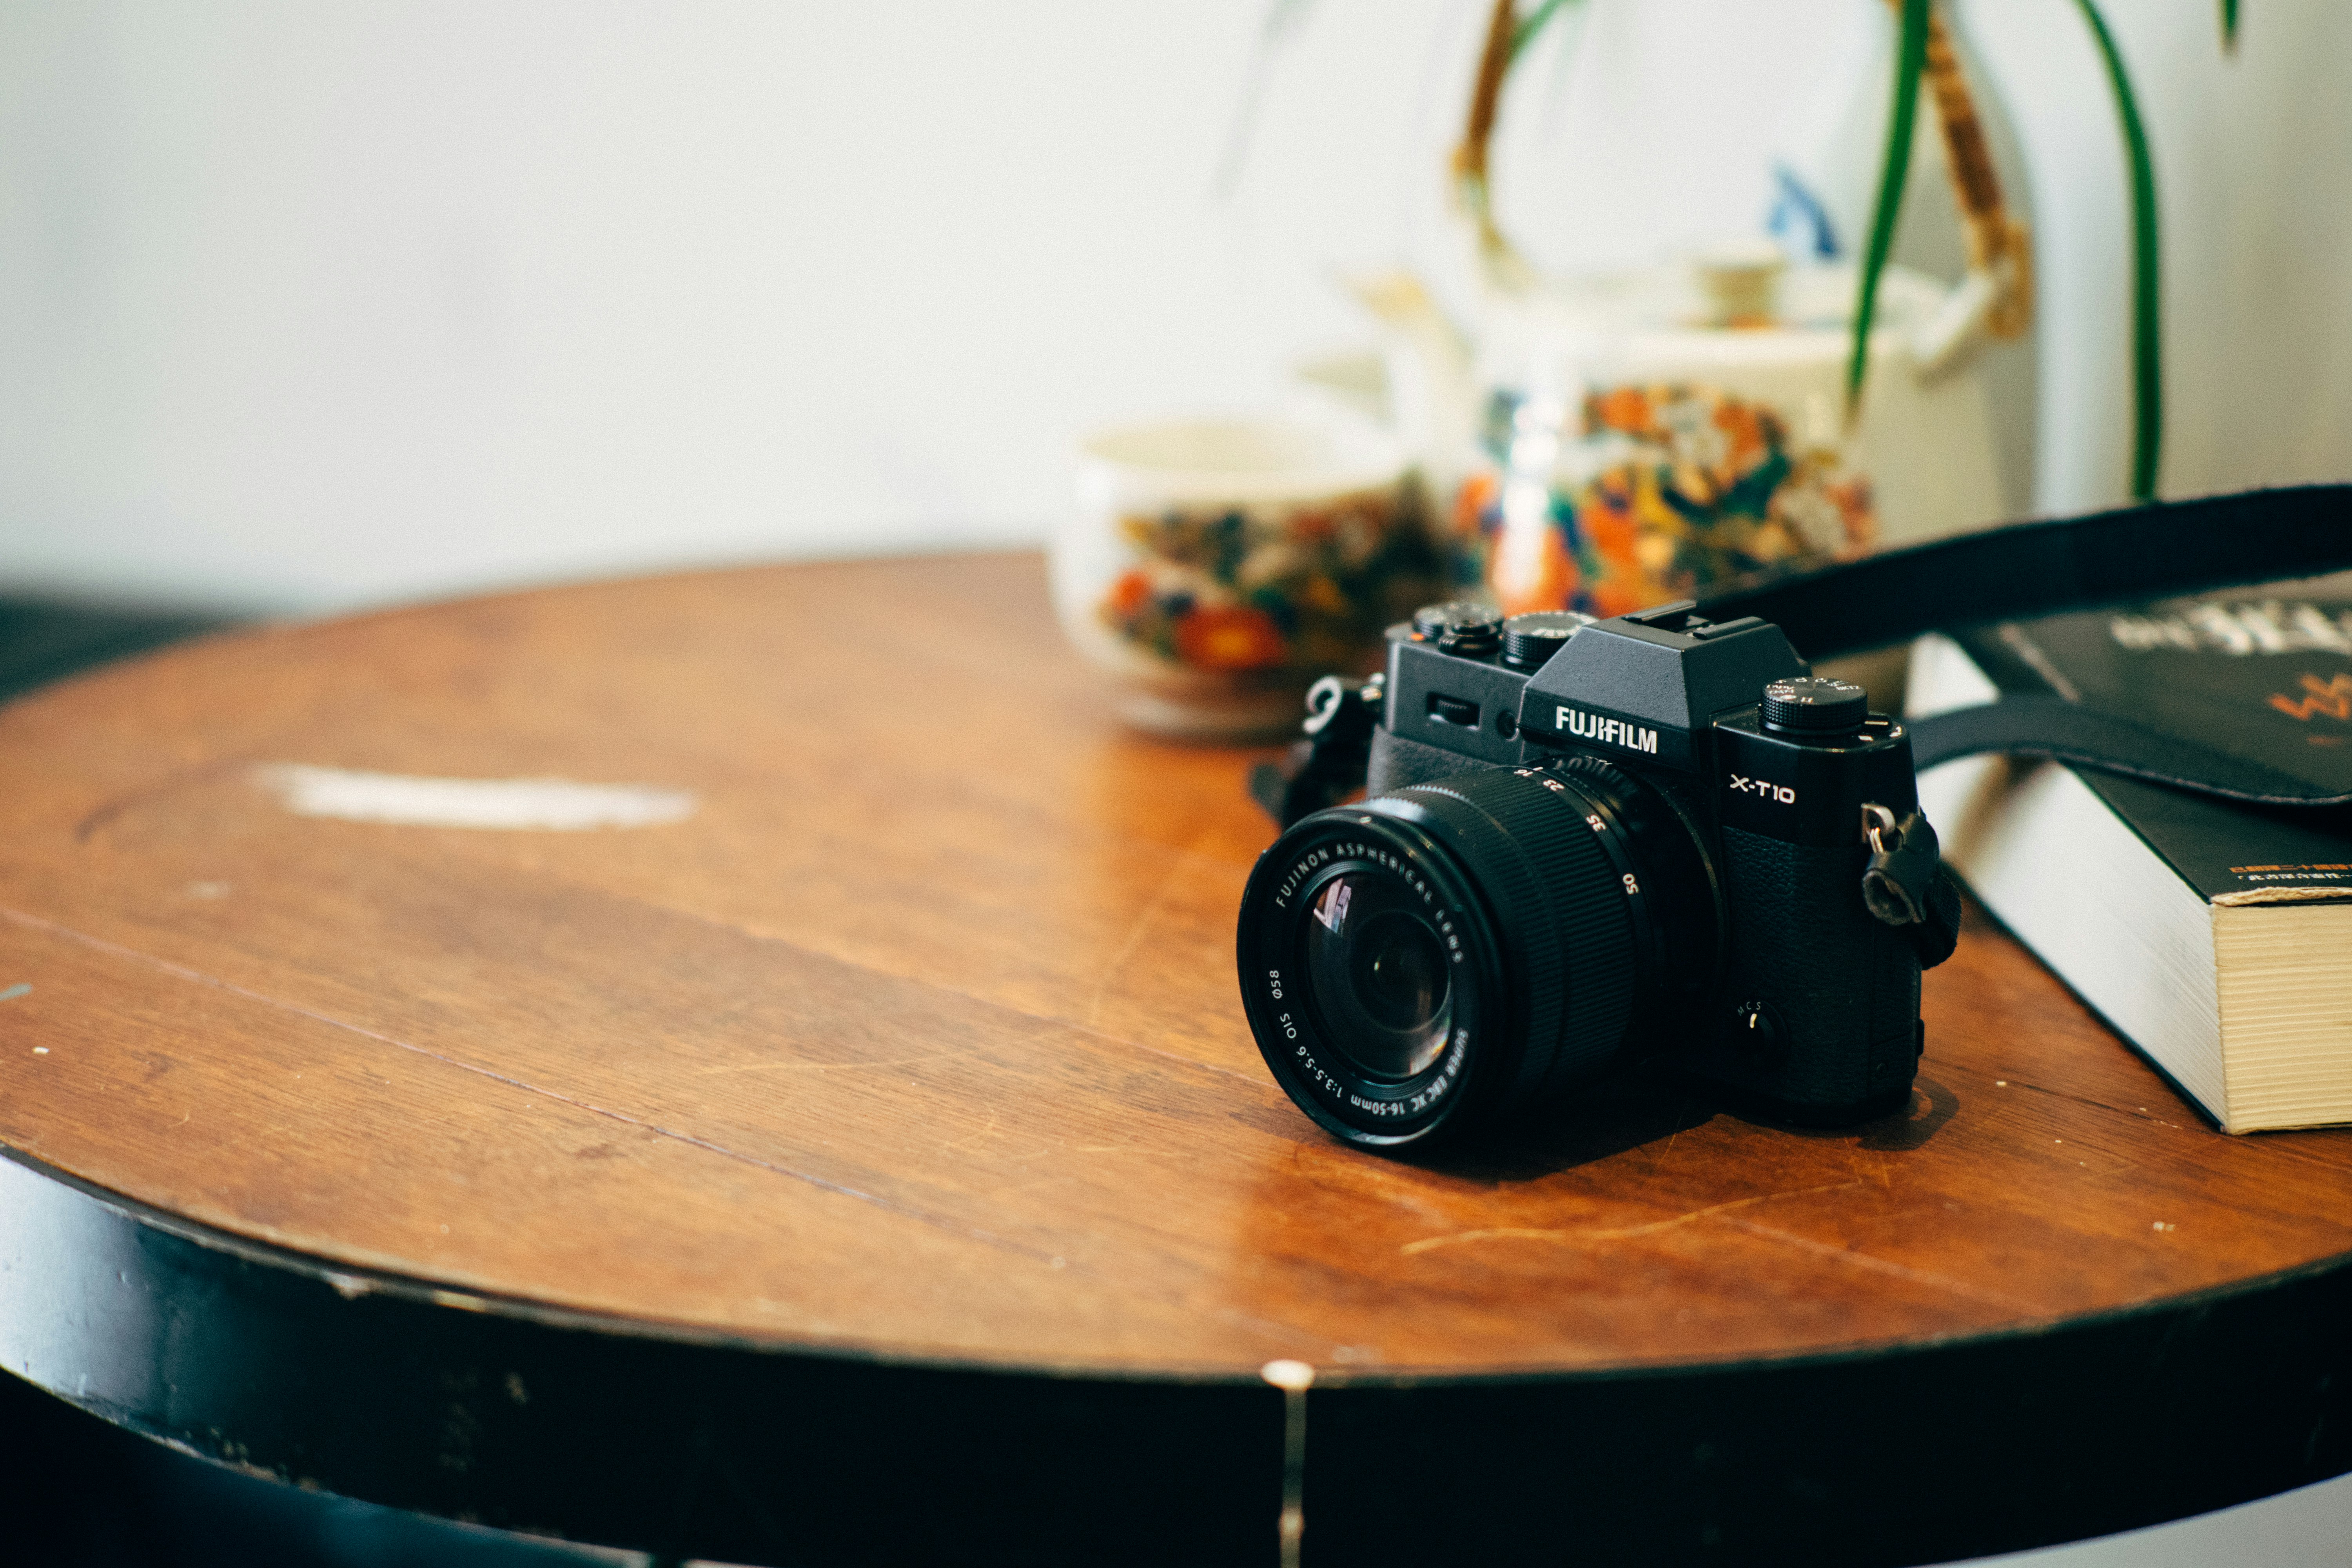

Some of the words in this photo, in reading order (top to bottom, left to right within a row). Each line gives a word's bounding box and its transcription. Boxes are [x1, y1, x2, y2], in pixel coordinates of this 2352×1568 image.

[1556, 706, 1657, 754] FUJIFILM
[1543, 779, 1564, 791] 23
[1730, 774, 1795, 804] X-T10
[1586, 815, 1607, 832] 35
[1276, 848, 1330, 907] FUJINON
[1336, 843, 1432, 905] ASPHERICAL
[1622, 873, 1639, 895] 50
[1737, 1006, 1744, 1016] M
[1746, 1001, 1751, 1010] C
[1756, 1002, 1761, 1010] S
[1280, 1013, 1296, 1039] OIS
[1296, 1046, 1343, 1098] 1:3.5-5.6
[1350, 1094, 1405, 1115] 16-50mm
[1411, 1093, 1427, 1112] XC
